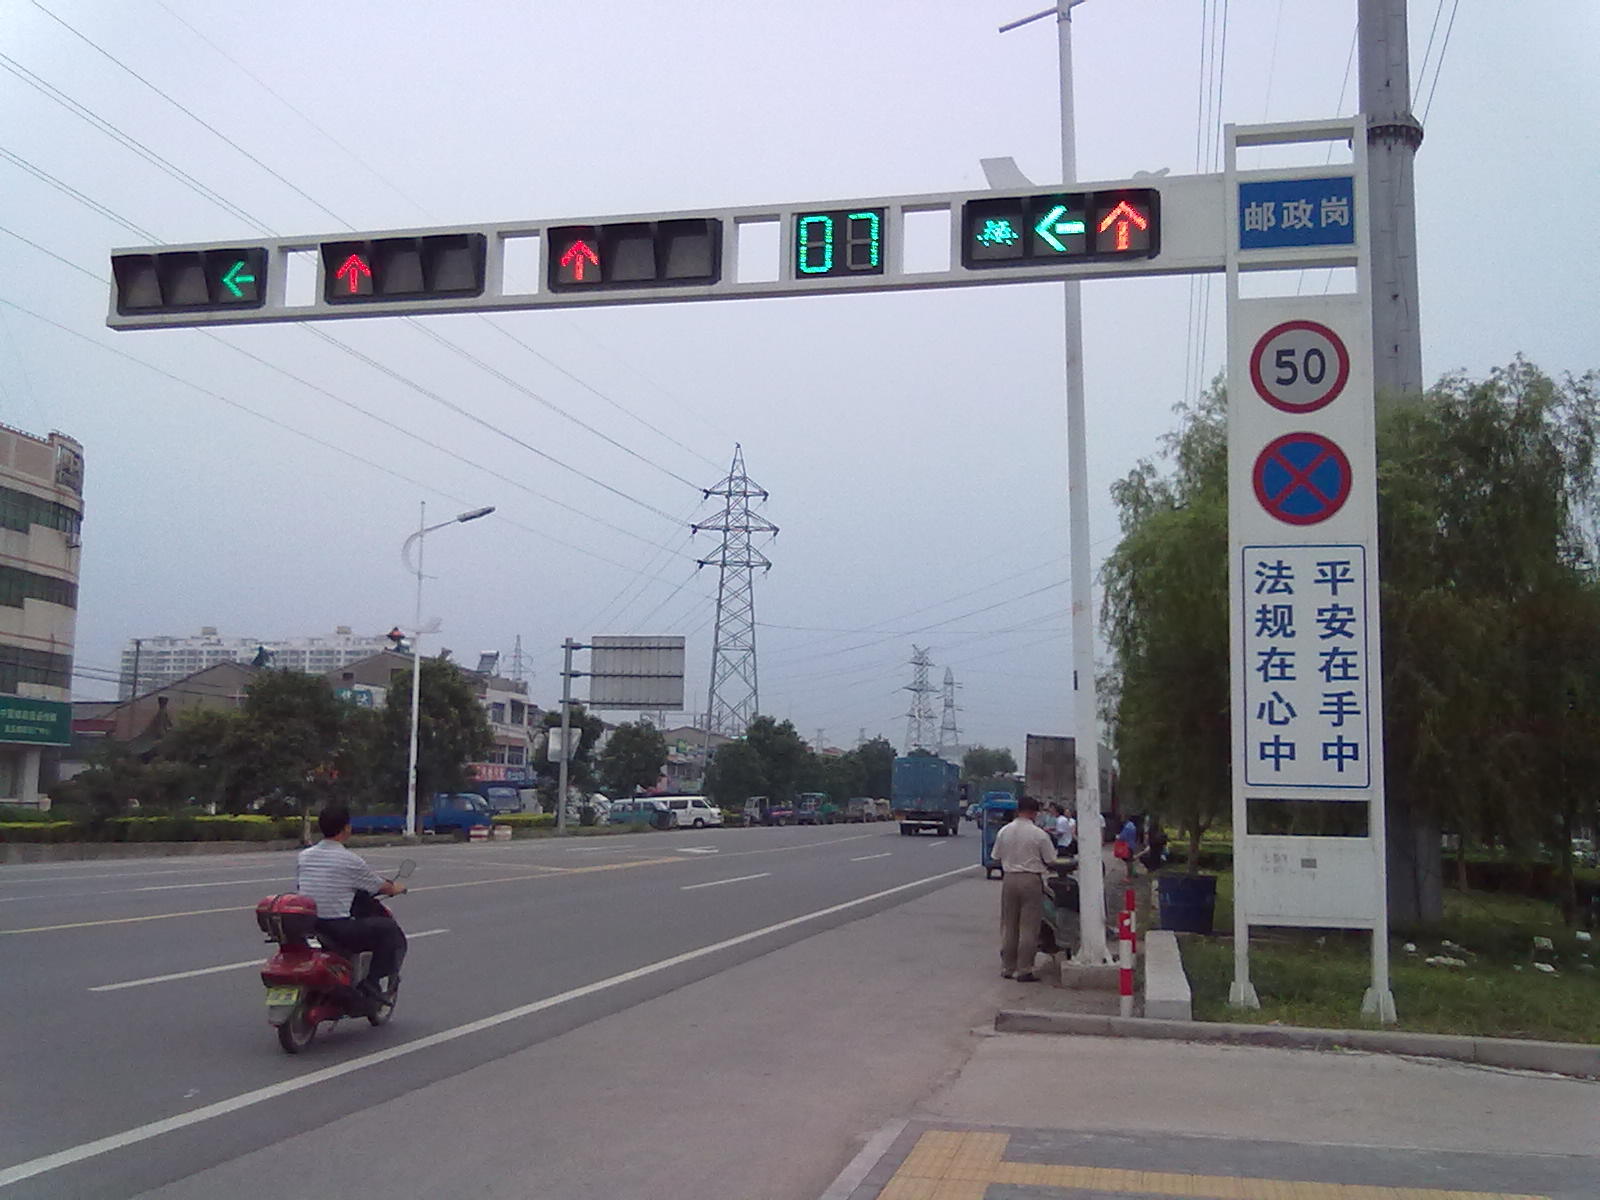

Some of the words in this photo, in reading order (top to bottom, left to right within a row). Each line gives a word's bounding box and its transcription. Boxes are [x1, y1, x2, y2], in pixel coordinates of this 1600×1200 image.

[800, 212, 879, 273] 07
[1244, 196, 1349, 232] 邮政岗
[1275, 347, 1326, 386] 50
[1254, 560, 1298, 772] 法规在心中
[1314, 560, 1362, 772] 平安在手中
